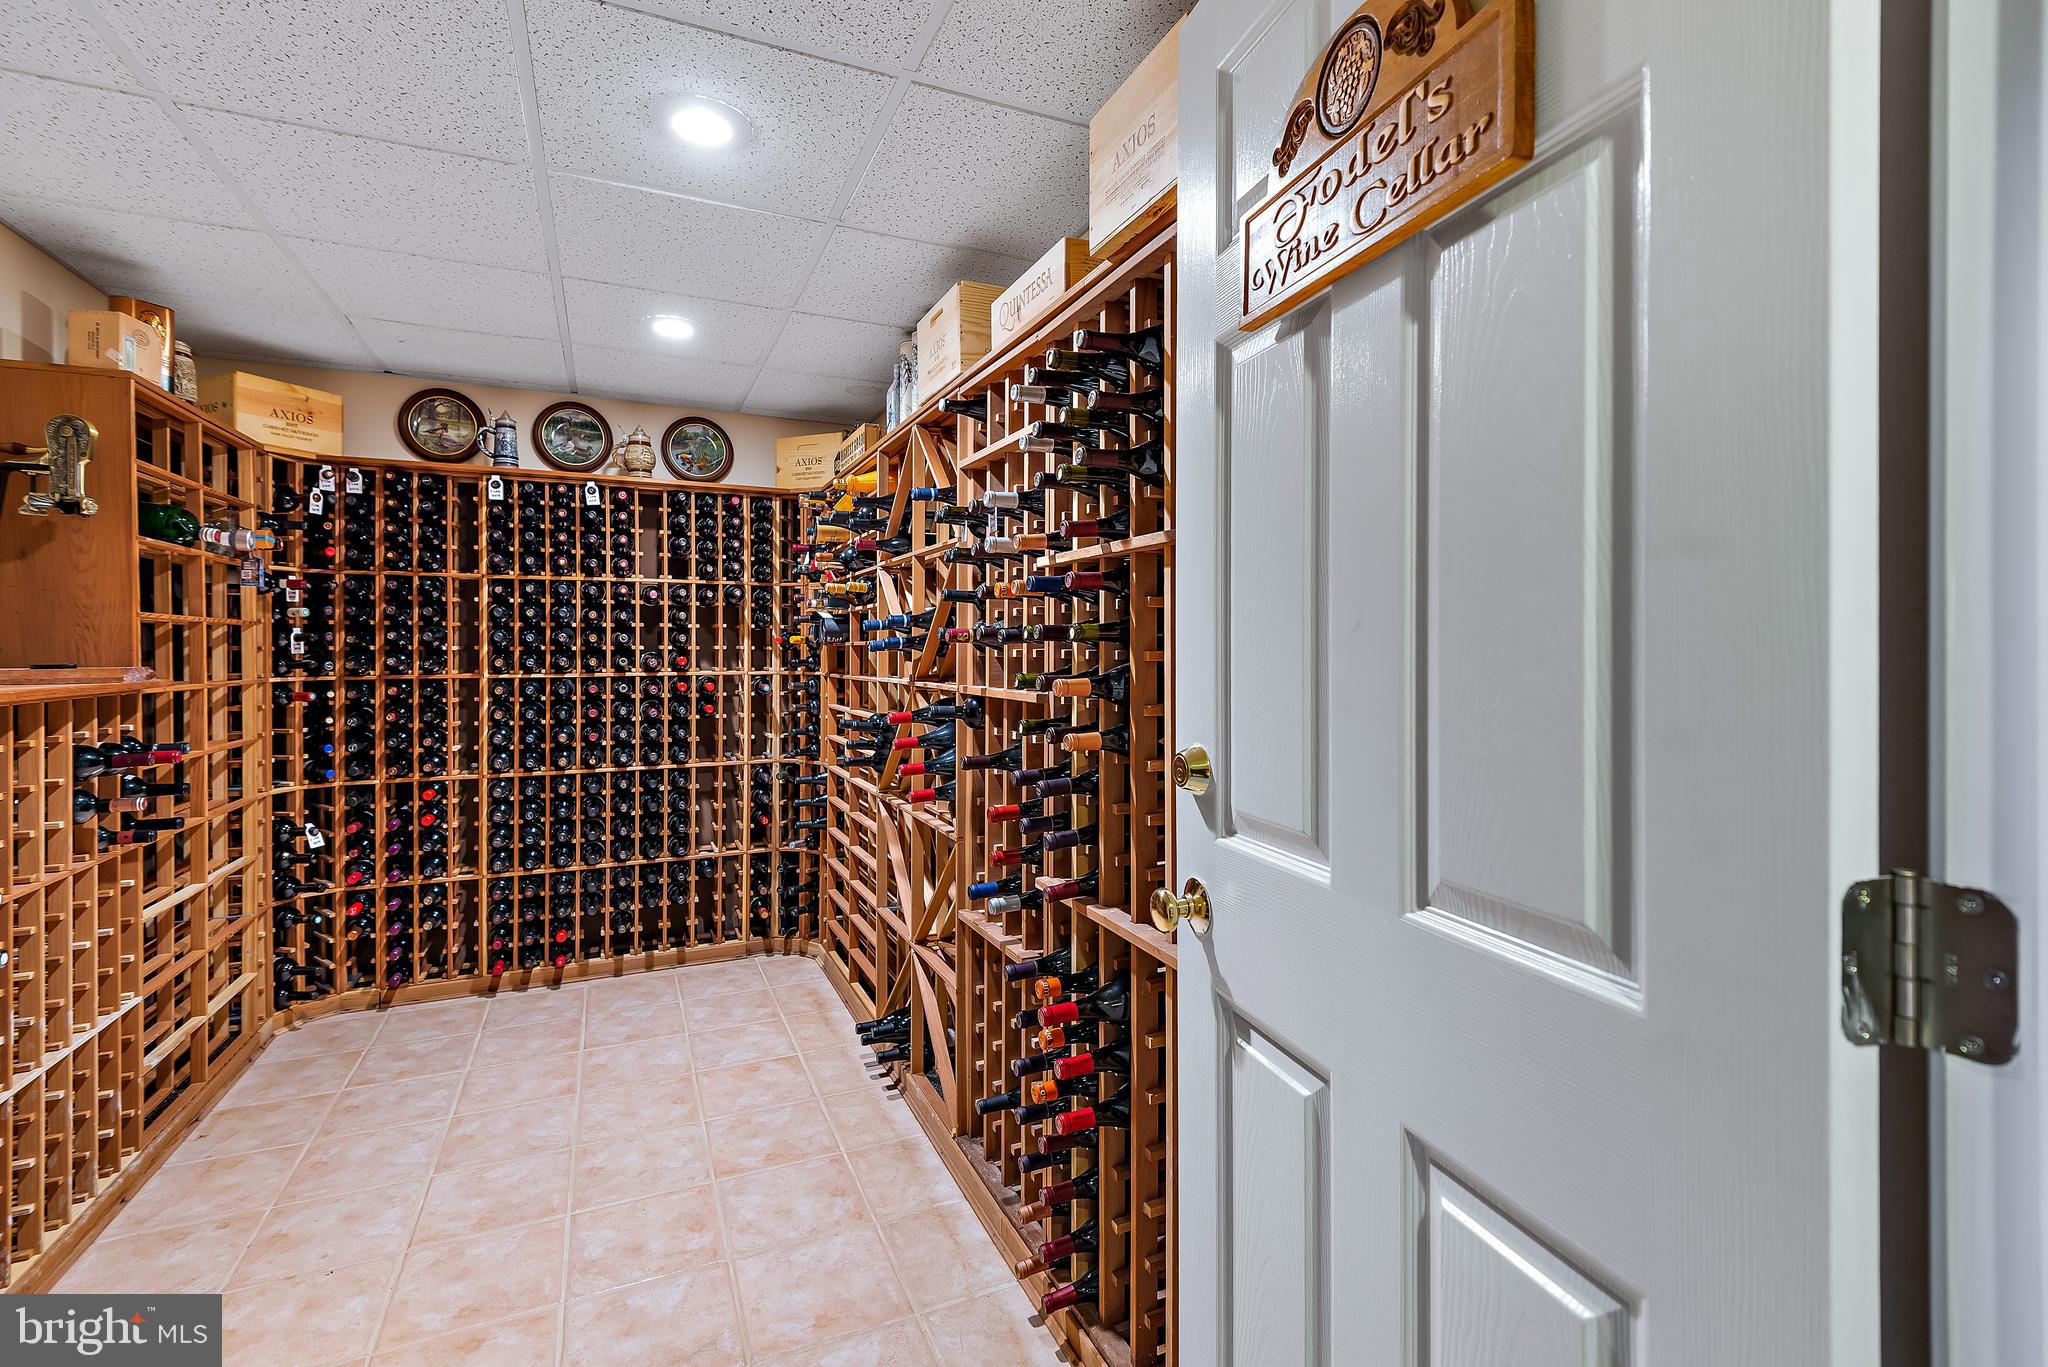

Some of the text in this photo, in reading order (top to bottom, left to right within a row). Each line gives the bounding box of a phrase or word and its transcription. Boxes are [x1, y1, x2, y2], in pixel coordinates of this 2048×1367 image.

[1112, 112, 1156, 174] AXIOS
[1252, 112, 1493, 294] Wine Cellar
[999, 267, 1053, 332] QUINTESSA
[270, 408, 314, 425] AXIOS
[795, 457, 823, 467] AXIOS
